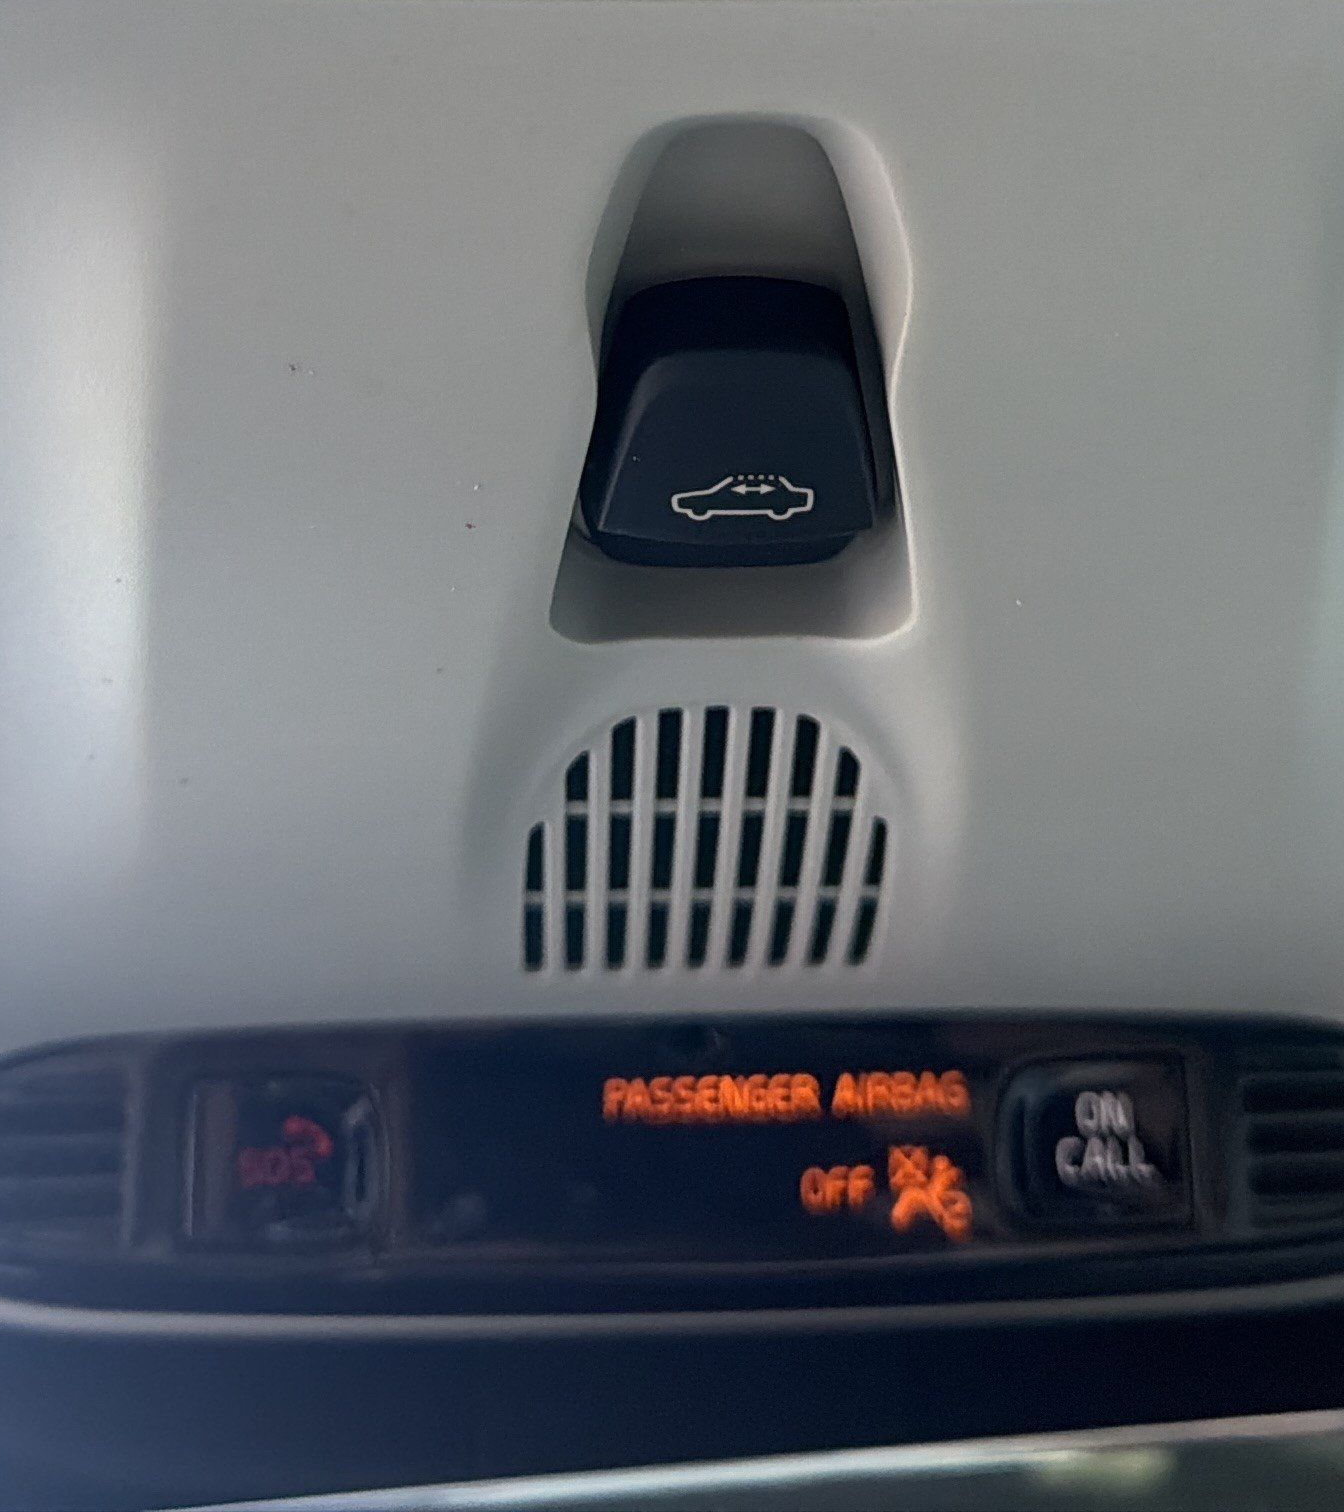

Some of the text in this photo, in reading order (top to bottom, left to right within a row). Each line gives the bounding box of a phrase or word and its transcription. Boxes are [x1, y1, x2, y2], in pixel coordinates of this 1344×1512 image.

[602, 1070, 971, 1123] PASSENGER AIRBAG
[1074, 1090, 1133, 1138] ON
[1056, 1137, 1154, 1186] CALL
[800, 1164, 874, 1214] OFF
